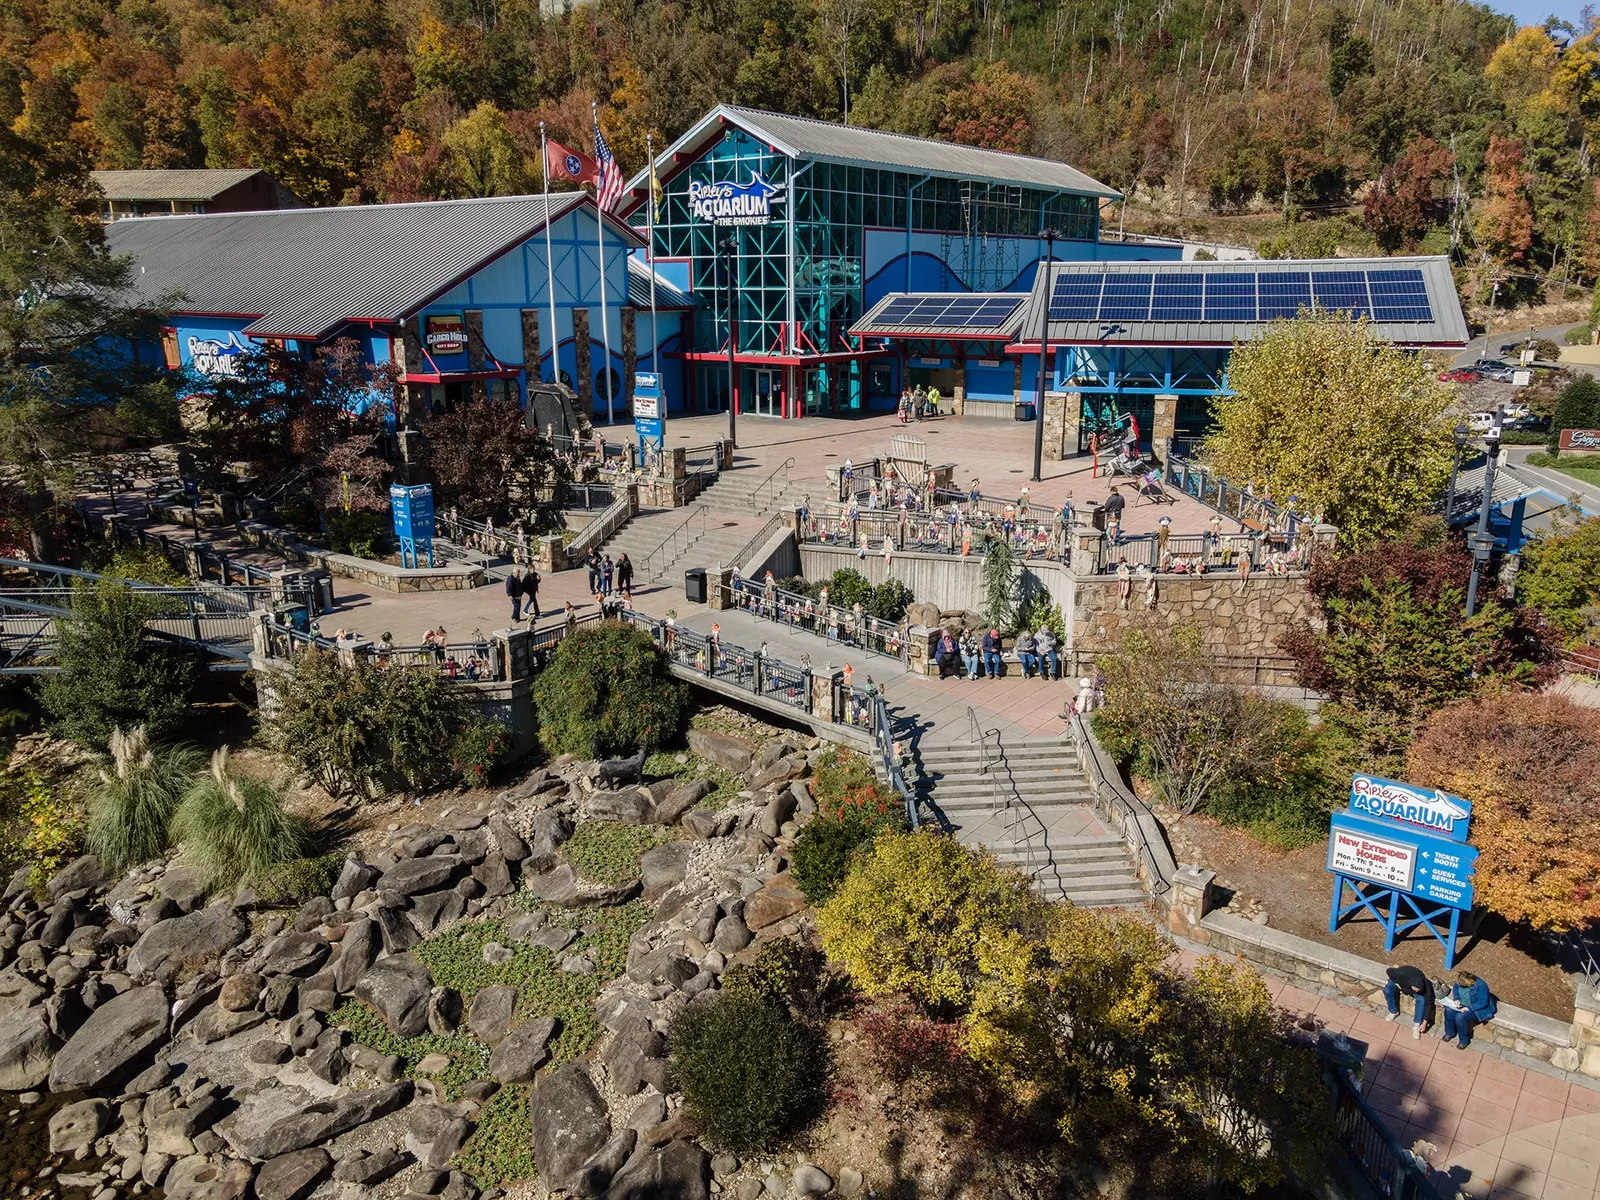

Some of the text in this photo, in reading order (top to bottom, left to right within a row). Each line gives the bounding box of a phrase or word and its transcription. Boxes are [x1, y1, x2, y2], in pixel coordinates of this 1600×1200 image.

[694, 194, 768, 221] AQUARIUM
[720, 217, 732, 226] THE
[733, 216, 769, 225] SMOKIES
[1354, 780, 1409, 804] Ripley's
[1356, 794, 1452, 831] AQUARIUM
[1338, 835, 1408, 860] NEW EXTENDED
[1337, 852, 1351, 861] Mon
[1356, 857, 1367, 865] Th:
[1356, 849, 1387, 864] HOURS
[1433, 857, 1459, 869] BOOTH
[1434, 851, 1460, 863] TICKET
[1335, 859, 1345, 867] Fri
[1350, 863, 1366, 873] Sun:
[1387, 873, 1396, 881] 10
[1432, 868, 1456, 879] GUEST
[1431, 874, 1467, 888] SERVICES
[1429, 890, 1459, 903] GARAGE
[1430, 884, 1462, 898] PARKING
